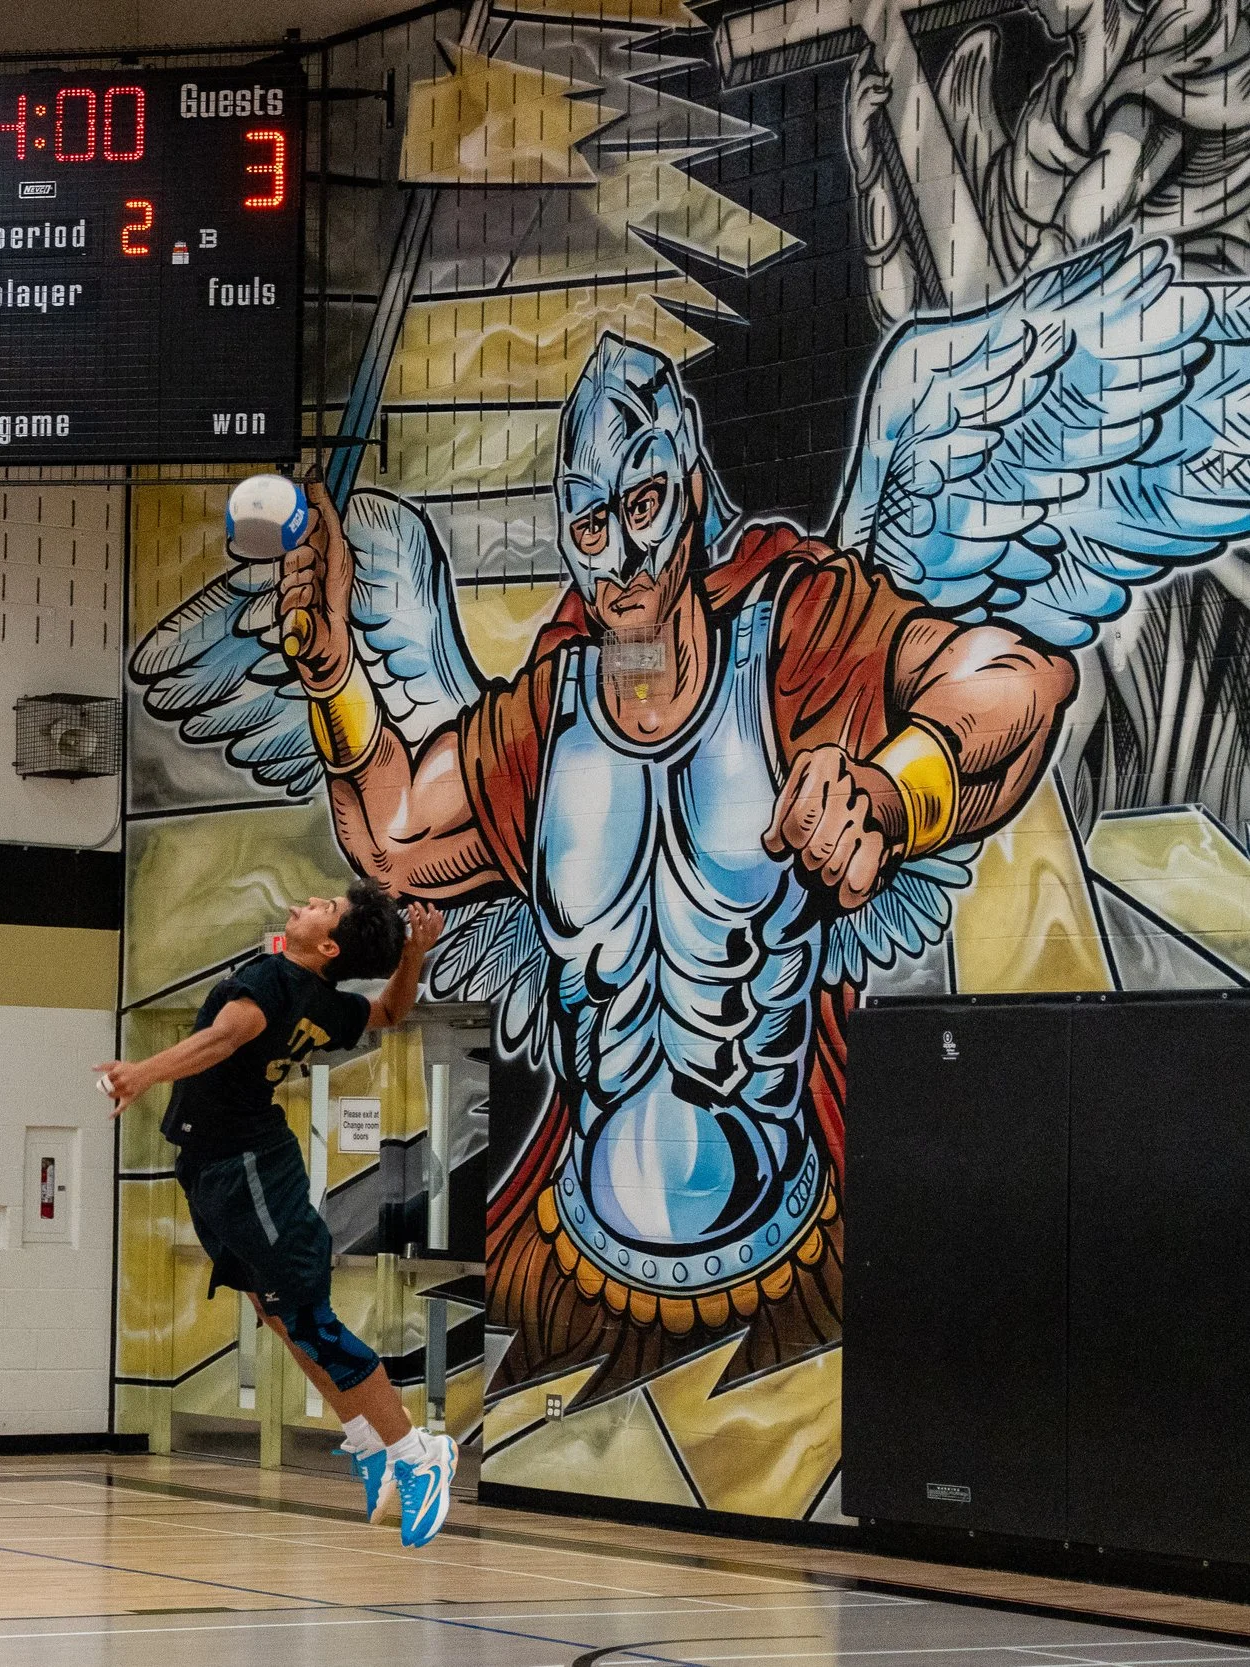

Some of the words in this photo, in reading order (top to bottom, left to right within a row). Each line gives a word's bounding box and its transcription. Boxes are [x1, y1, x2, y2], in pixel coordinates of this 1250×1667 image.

[180, 83, 284, 119] Guests
[244, 130, 287, 208] 3
[23, 184, 52, 195] NEVCO
[121, 200, 154, 255] 2
[199, 229, 218, 248] B
[208, 276, 277, 307] fouls
[212, 409, 266, 435] won
[343, 1110, 361, 1118] Please
[362, 1110, 372, 1118] exit
[343, 1121, 364, 1130] Change
